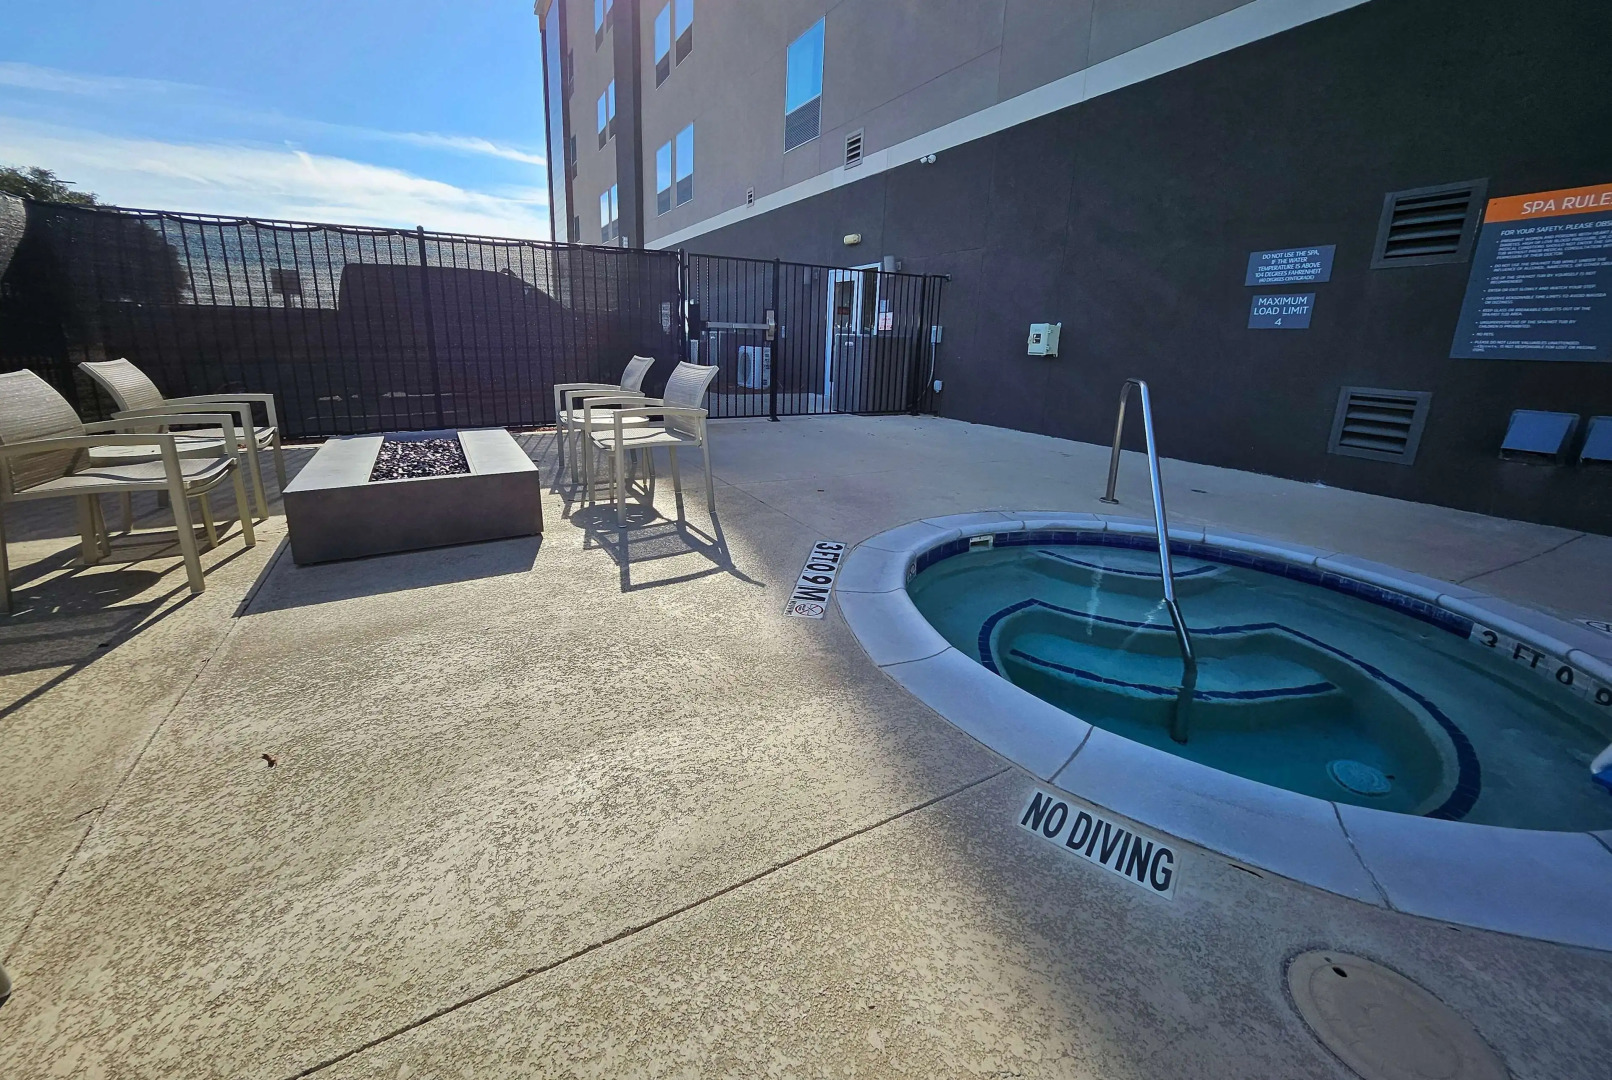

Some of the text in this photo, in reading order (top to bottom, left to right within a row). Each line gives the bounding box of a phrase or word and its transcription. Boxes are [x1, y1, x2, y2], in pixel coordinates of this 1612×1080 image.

[1522, 192, 1612, 214] SPA RULE
[1564, 222, 1594, 230] PLEASE
[1258, 296, 1307, 306] MAXIMUM
[1254, 306, 1310, 315] LOAD LIMIT
[1020, 792, 1174, 892] NO DIVING
